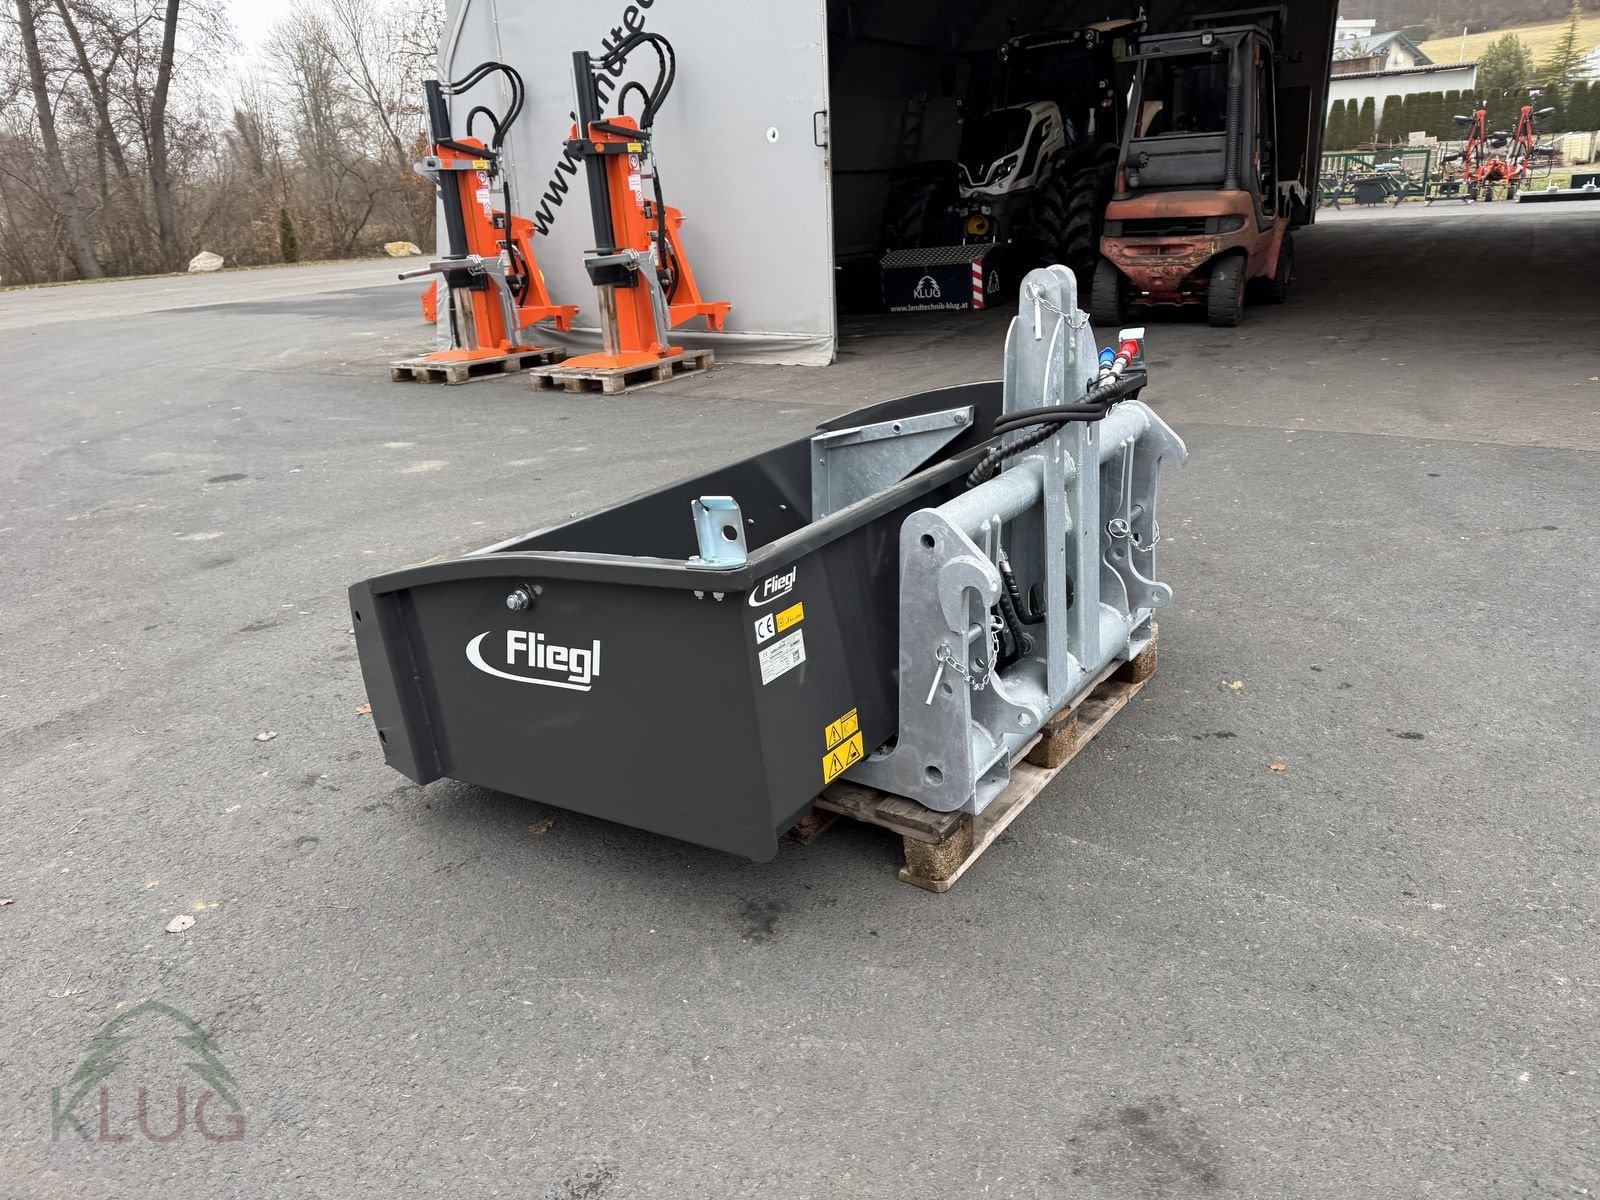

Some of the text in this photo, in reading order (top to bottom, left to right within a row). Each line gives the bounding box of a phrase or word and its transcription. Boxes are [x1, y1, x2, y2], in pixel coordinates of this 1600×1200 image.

[913, 288, 941, 299] KLUG
[890, 302, 968, 312] www.landtechnik-klug.at
[763, 566, 797, 597] Fliegl
[758, 617, 773, 638] CE
[507, 629, 601, 684] Fliegl
